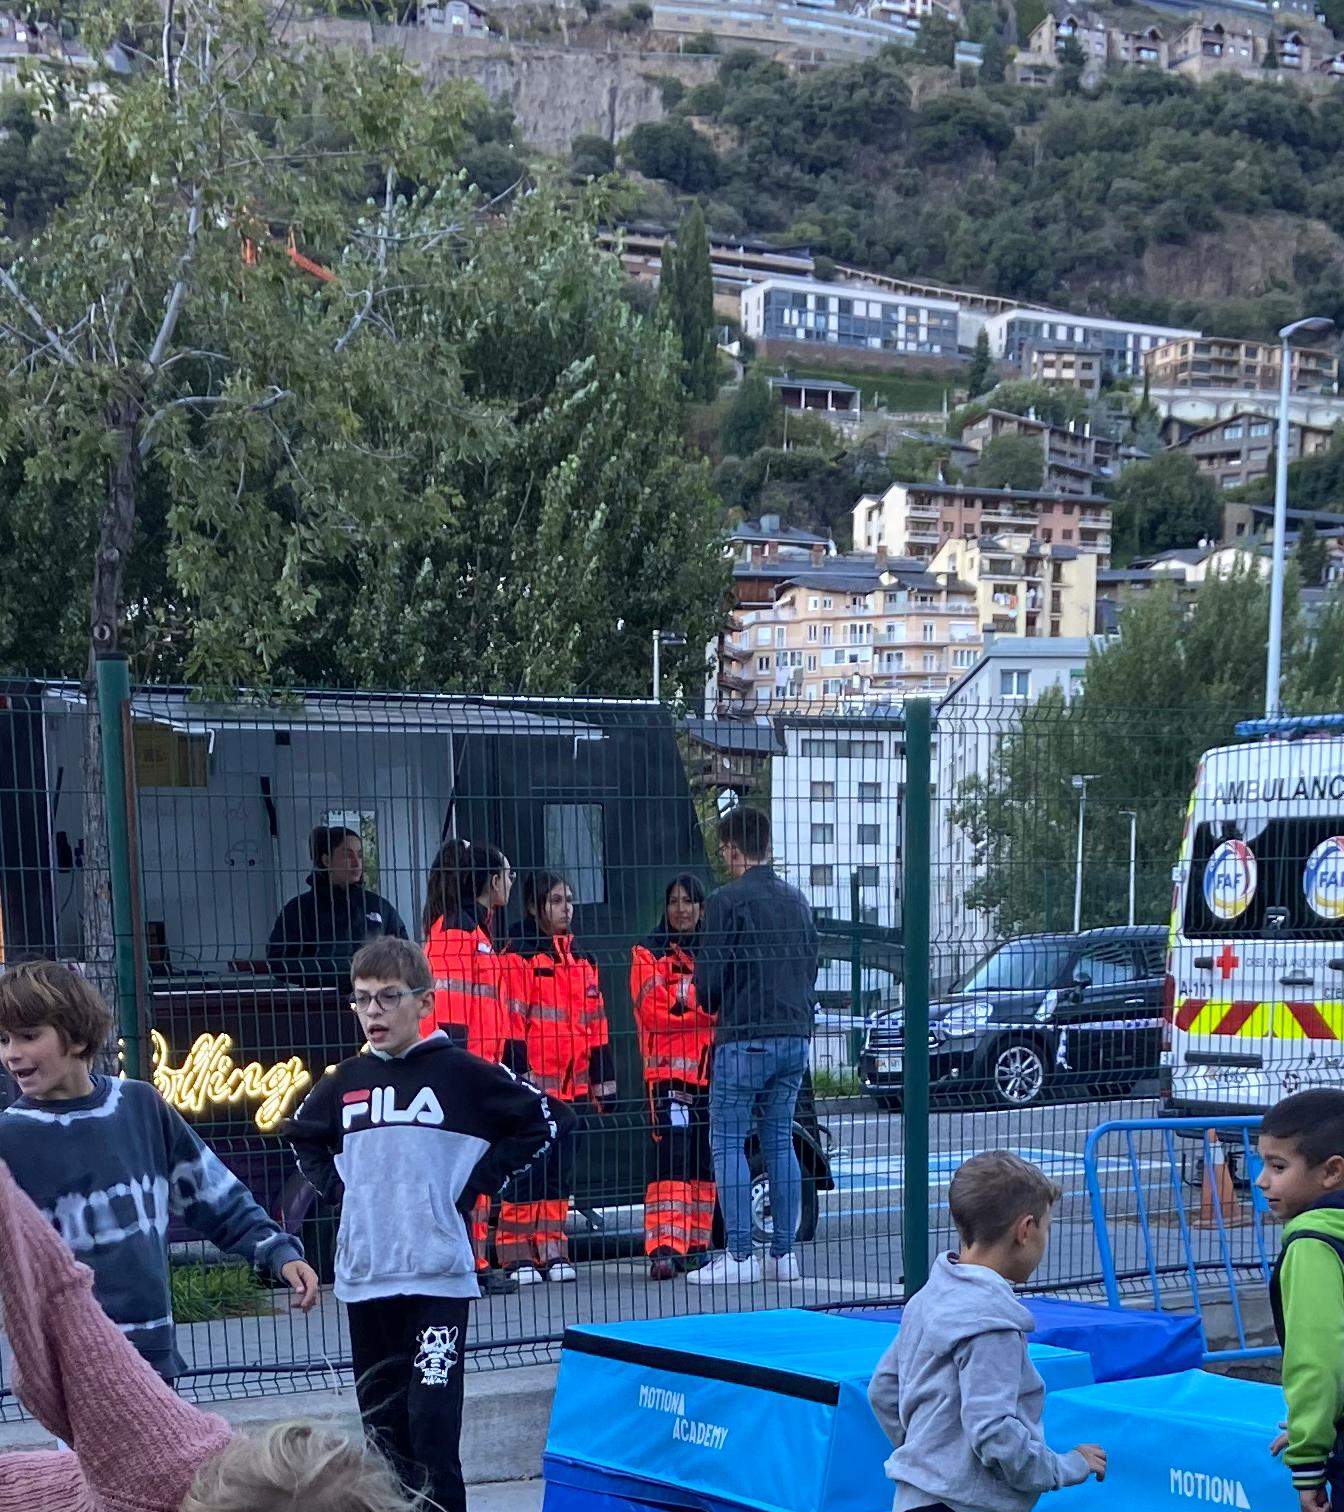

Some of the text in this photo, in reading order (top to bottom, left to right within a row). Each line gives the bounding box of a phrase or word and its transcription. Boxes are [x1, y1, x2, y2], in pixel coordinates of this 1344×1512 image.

[1216, 872, 1243, 890] FAF
[342, 1086, 444, 1129] FILA
[639, 1384, 679, 1415] MOTION
[672, 1417, 728, 1450] ACADEMY
[1170, 1468, 1234, 1507] MOTION
